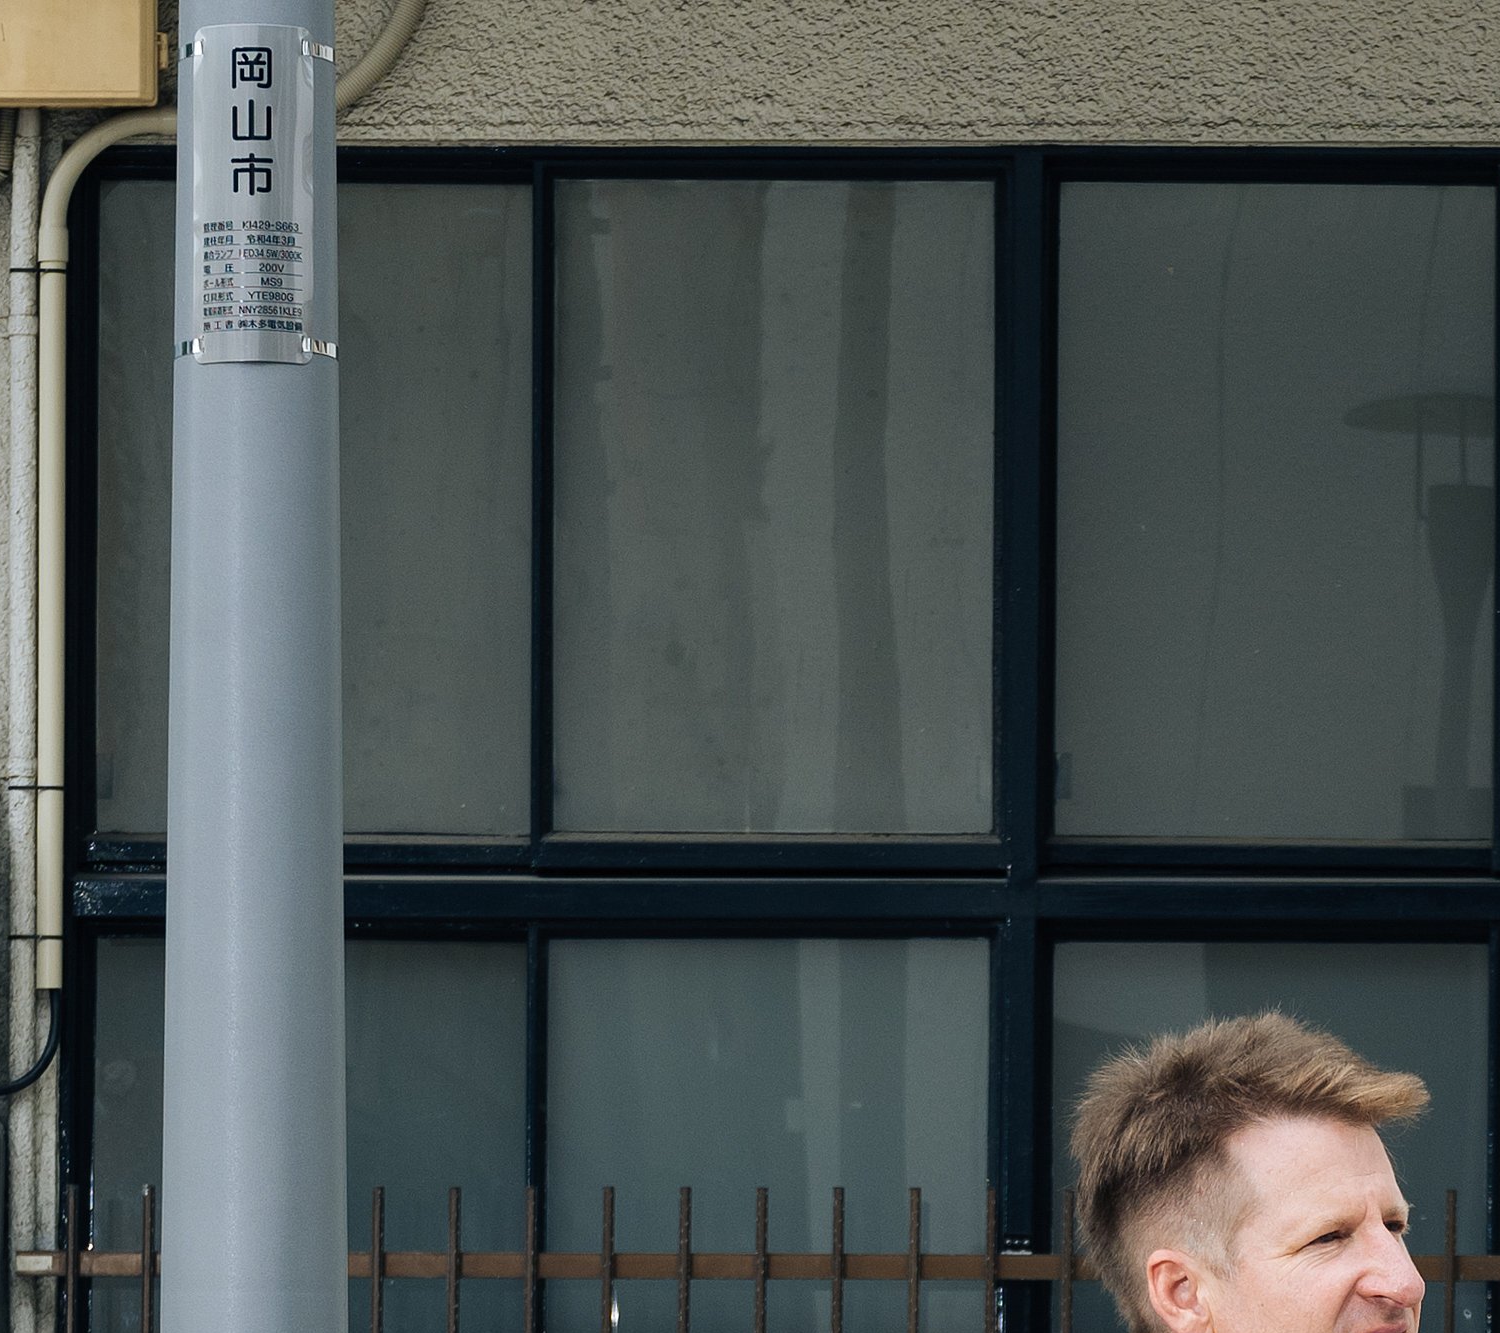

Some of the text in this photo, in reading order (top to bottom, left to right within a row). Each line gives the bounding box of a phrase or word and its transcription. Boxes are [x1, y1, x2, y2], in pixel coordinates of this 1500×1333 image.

[231, 46, 274, 196] 岡山市
[246, 234, 295, 246] 令和4年3月
[259, 263, 285, 273] 200V
[260, 277, 283, 287] MS9
[248, 291, 295, 302] YTE980G
